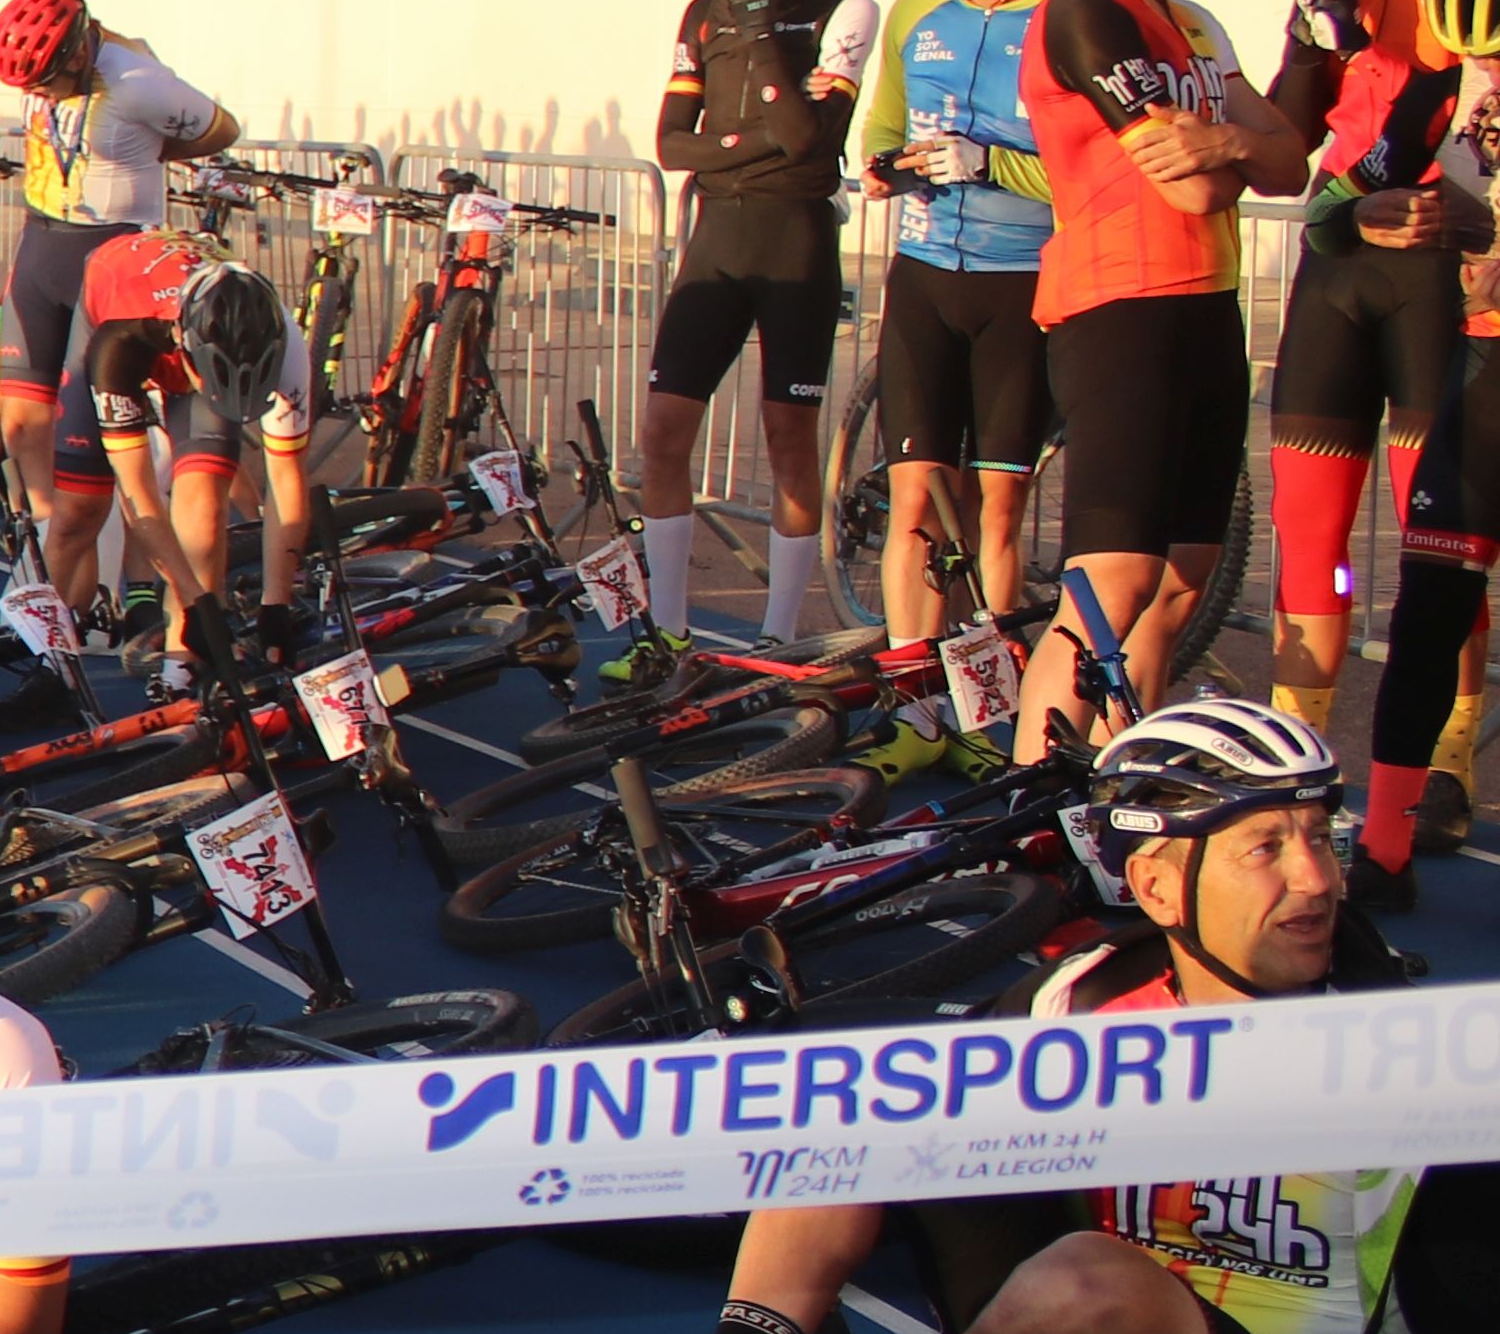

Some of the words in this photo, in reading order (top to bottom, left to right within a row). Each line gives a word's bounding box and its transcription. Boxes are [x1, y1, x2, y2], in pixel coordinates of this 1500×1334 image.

[913, 40, 942, 52] SOY
[915, 30, 935, 41] YO
[912, 50, 956, 63] GENAL
[1405, 530, 1478, 556] Emirates
[974, 658, 1004, 718] 5923
[338, 685, 371, 727] 677
[1216, 740, 1250, 764] ABUS
[1113, 812, 1159, 832] ABUS
[243, 842, 294, 916] 7413
[533, 1018, 1233, 1145] INTERSPORT
[967, 1139, 1001, 1155] 101
[1006, 1132, 1049, 1152] KM
[1053, 1133, 1081, 1150] 24
[1088, 1128, 1109, 1147] H
[807, 1145, 870, 1171] KM
[956, 1162, 990, 1181] LA
[996, 1154, 1099, 1178] LEGIÓN
[787, 1171, 862, 1200] 24H
[1217, 1256, 1264, 1277] NOS
